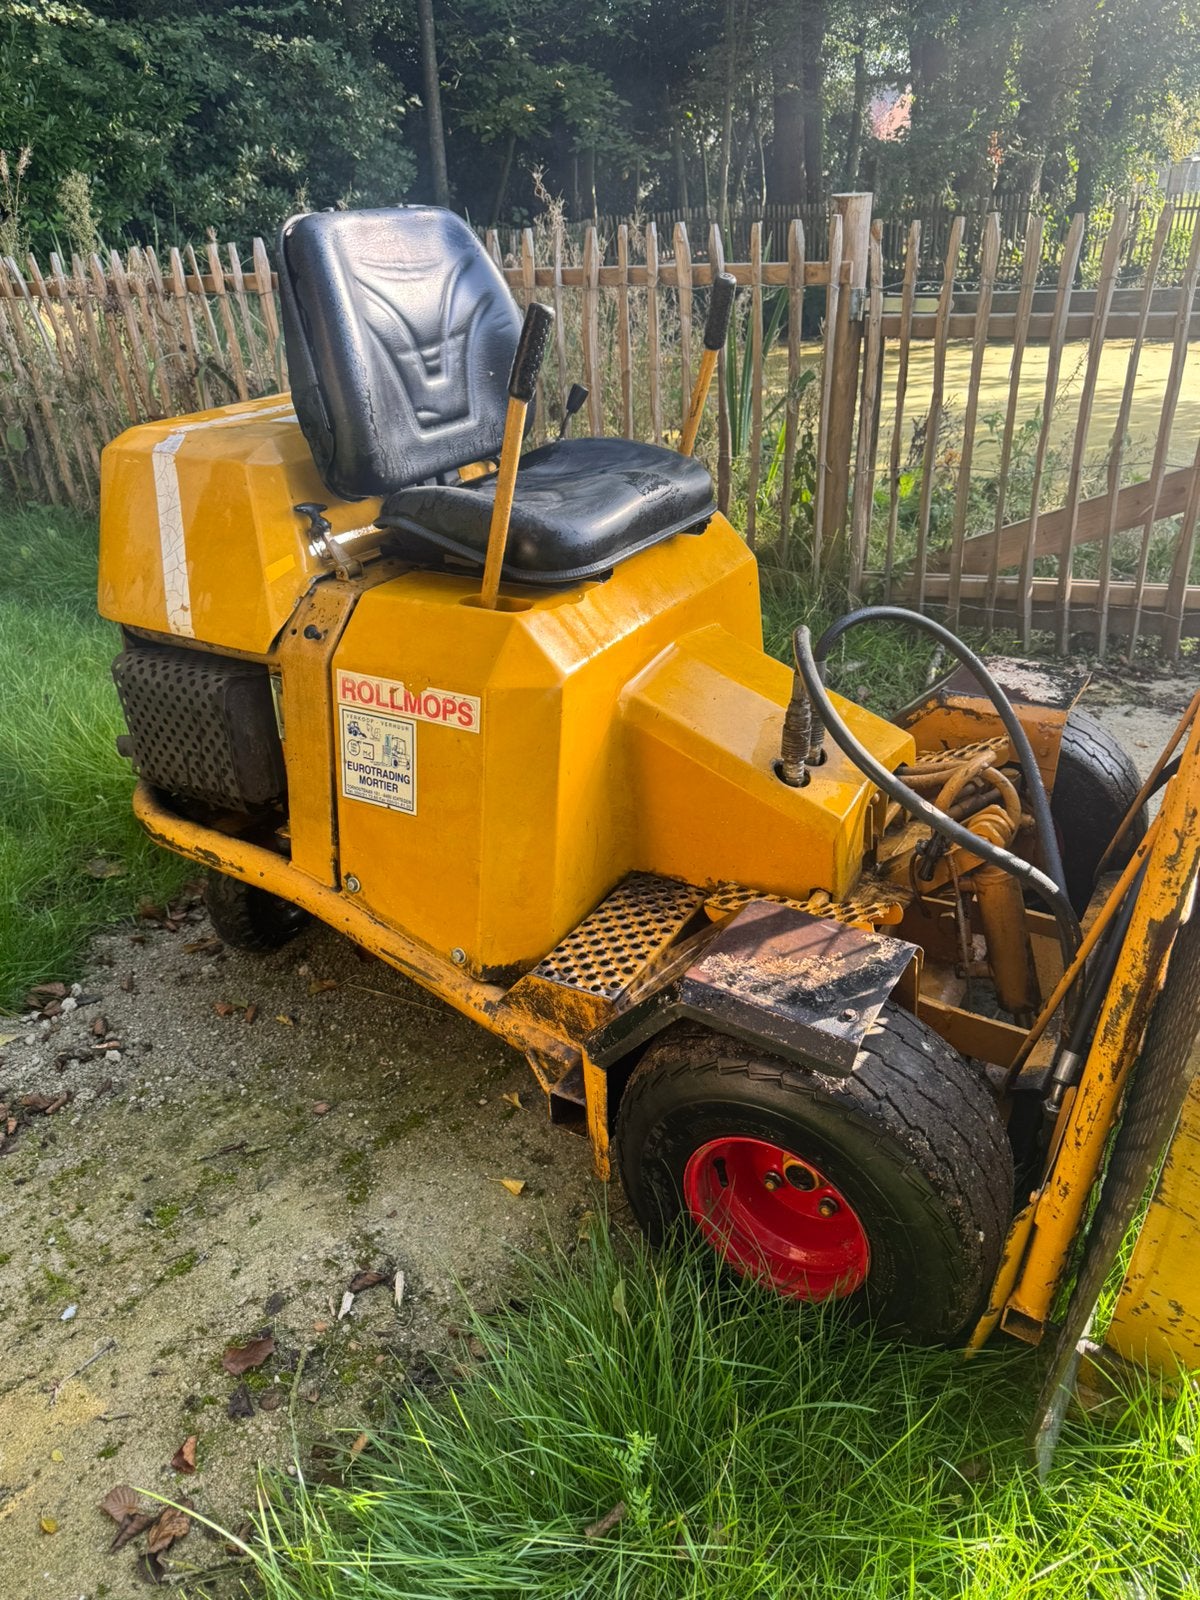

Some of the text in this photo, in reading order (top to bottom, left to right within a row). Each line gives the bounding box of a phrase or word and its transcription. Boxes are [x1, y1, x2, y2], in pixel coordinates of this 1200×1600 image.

[341, 676, 473, 727] ROLLMOPS
[347, 760, 411, 785] EUROTRADING
[359, 775, 399, 794] MORTIER
